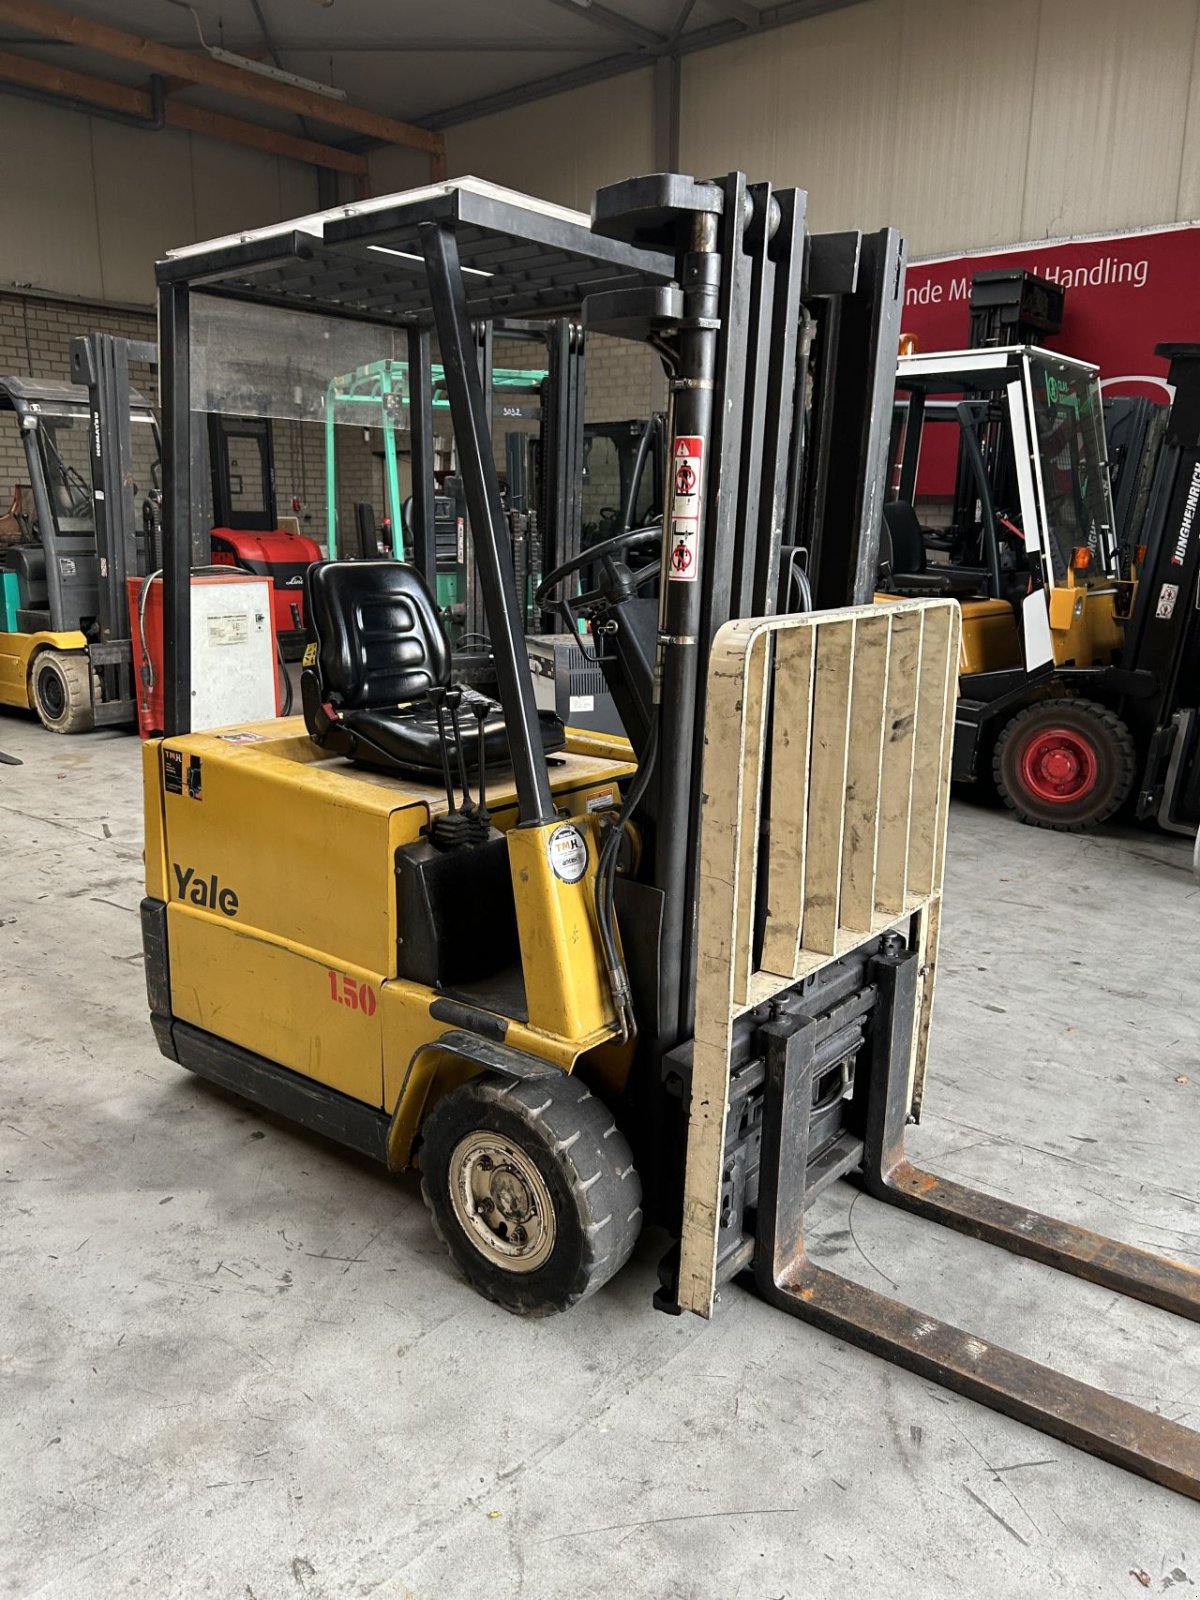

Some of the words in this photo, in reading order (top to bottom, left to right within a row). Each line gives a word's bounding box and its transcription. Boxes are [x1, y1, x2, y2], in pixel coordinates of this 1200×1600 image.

[906, 279, 943, 306] nde
[1046, 257, 1148, 288] Handling
[1170, 462, 1200, 567] JUNGHEINRICH
[555, 838, 581, 852] TMH
[173, 863, 239, 917] Yale
